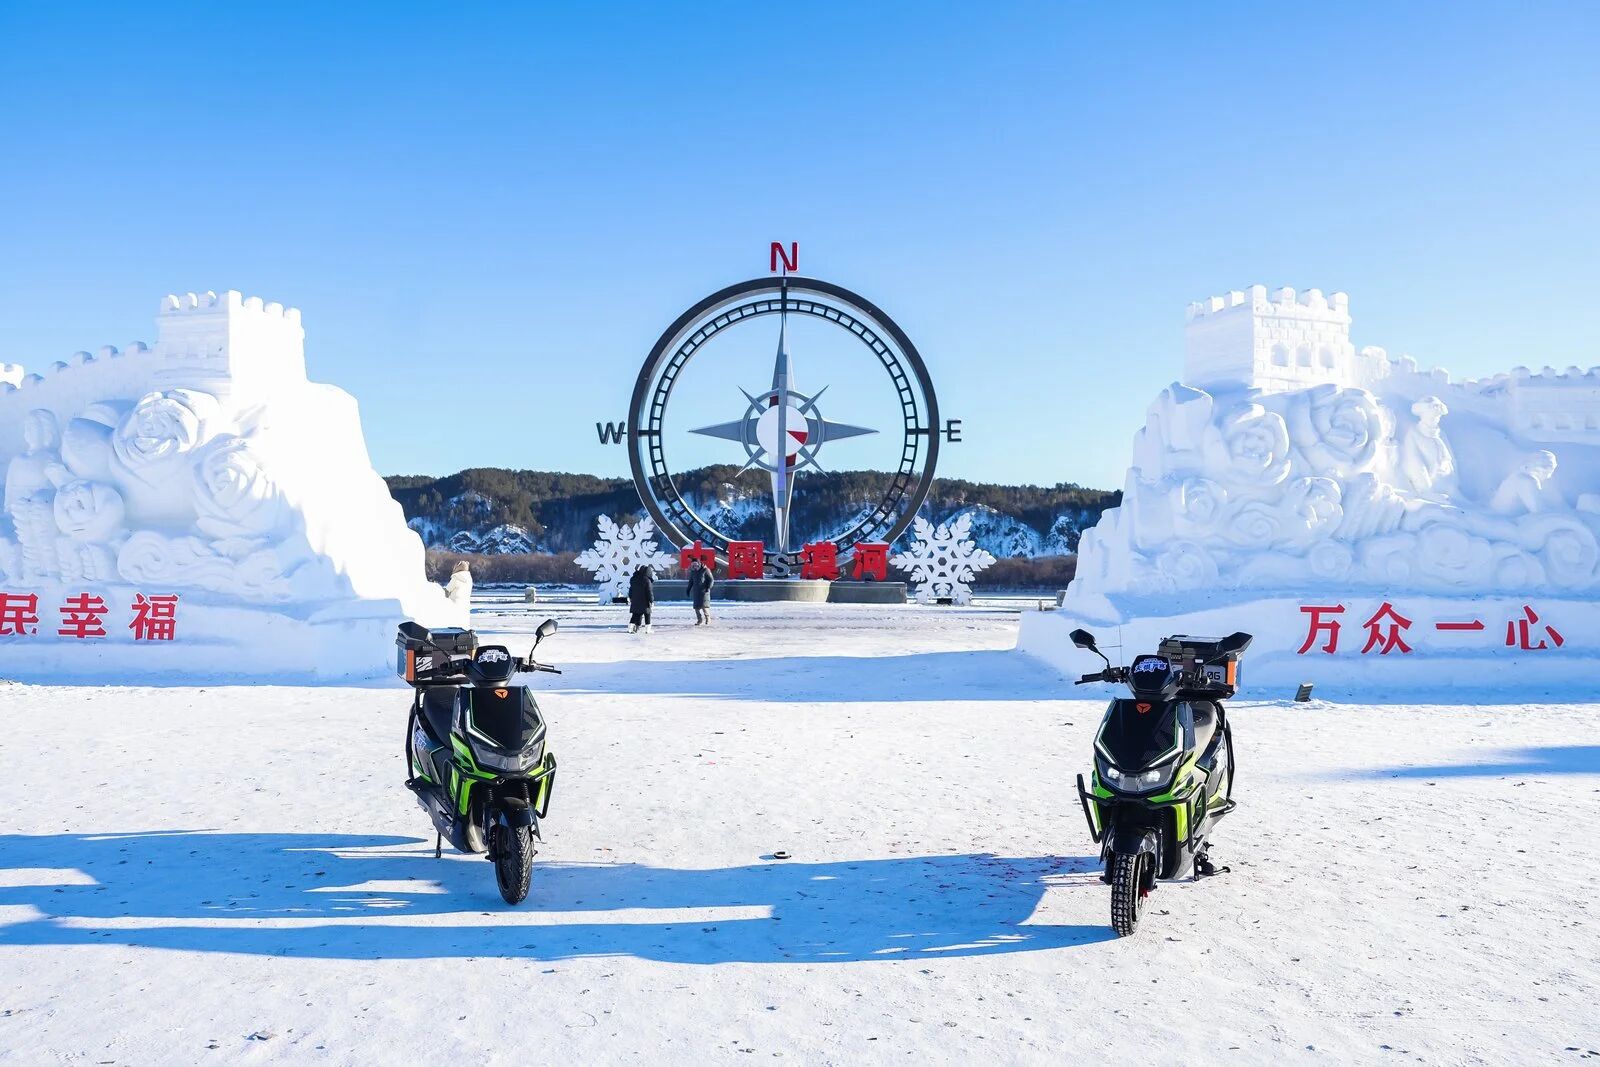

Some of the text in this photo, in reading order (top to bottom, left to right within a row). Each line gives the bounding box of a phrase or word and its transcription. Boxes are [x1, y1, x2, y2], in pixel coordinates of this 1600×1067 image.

[770, 241, 799, 274] N
[596, 421, 626, 445] W
[946, 419, 963, 443] E
[772, 552, 790, 577] S
[1296, 600, 1566, 656] 万众一心
